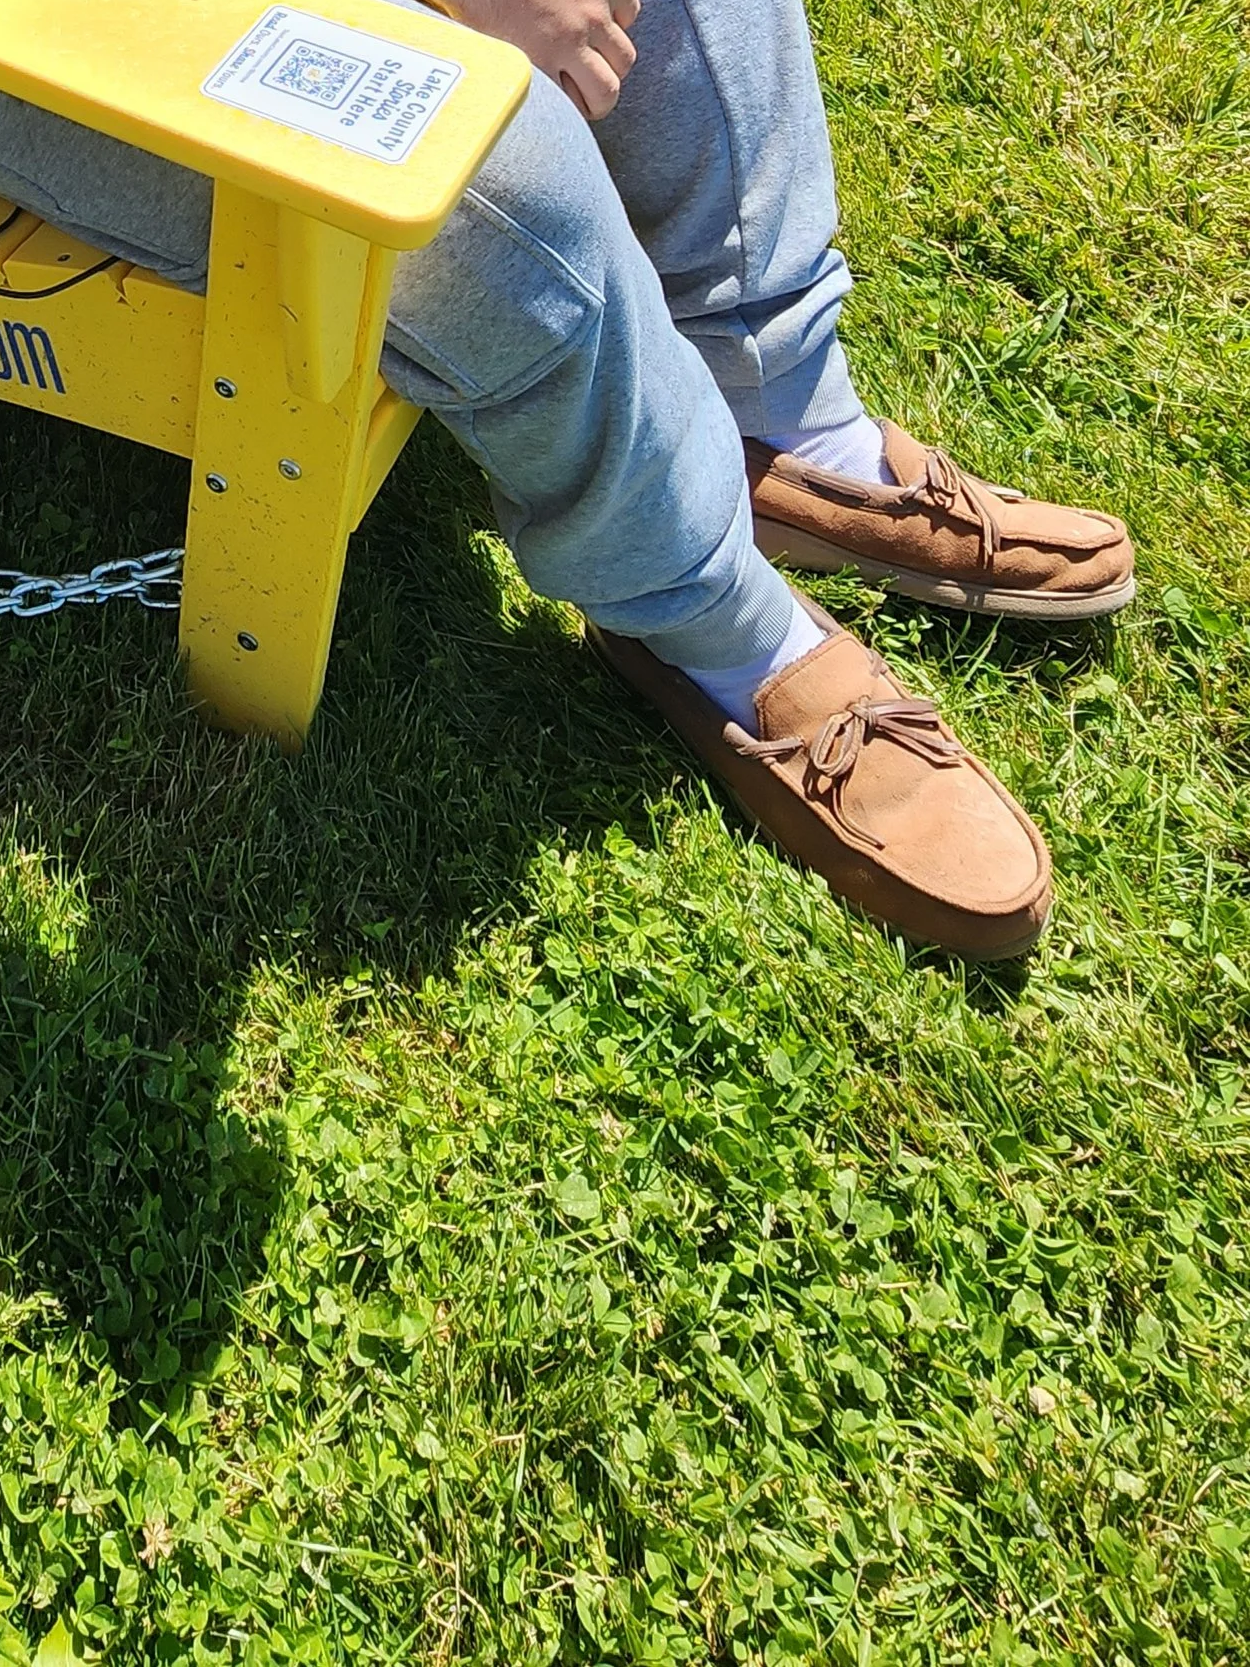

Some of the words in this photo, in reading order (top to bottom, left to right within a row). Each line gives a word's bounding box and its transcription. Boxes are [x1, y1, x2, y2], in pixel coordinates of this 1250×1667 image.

[263, 11, 289, 31] Read
[229, 46, 257, 70] Share
[363, 59, 403, 94] Start
[415, 68, 452, 99] Lake
[339, 94, 378, 127] Here
[371, 79, 416, 121] Stories
[376, 102, 427, 152] County
